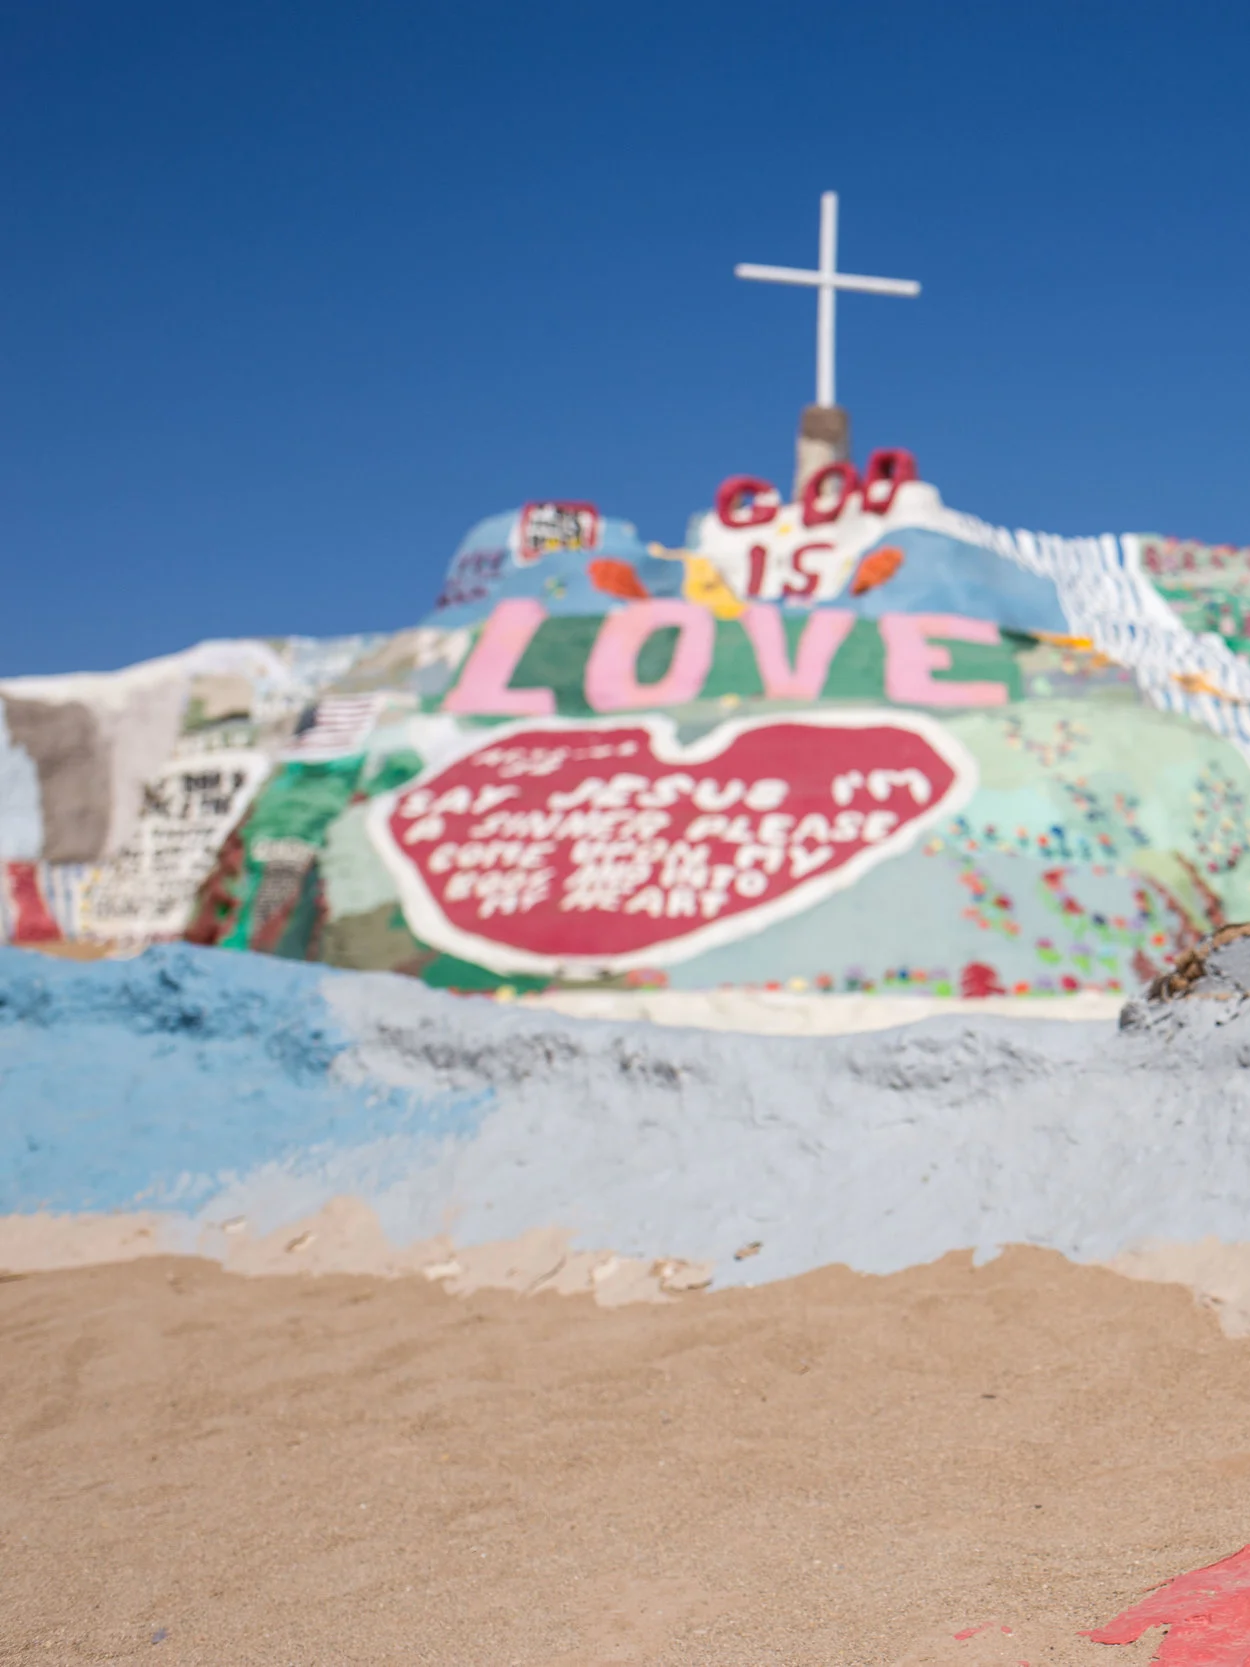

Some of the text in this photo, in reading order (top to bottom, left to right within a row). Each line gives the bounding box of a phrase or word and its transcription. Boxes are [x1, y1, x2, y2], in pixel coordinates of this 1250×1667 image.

[714, 446, 918, 529] GOD
[747, 542, 837, 597] IS
[440, 597, 1008, 717] LOVE
[547, 773, 788, 811] JESUS
[685, 809, 898, 844] PLEASE
